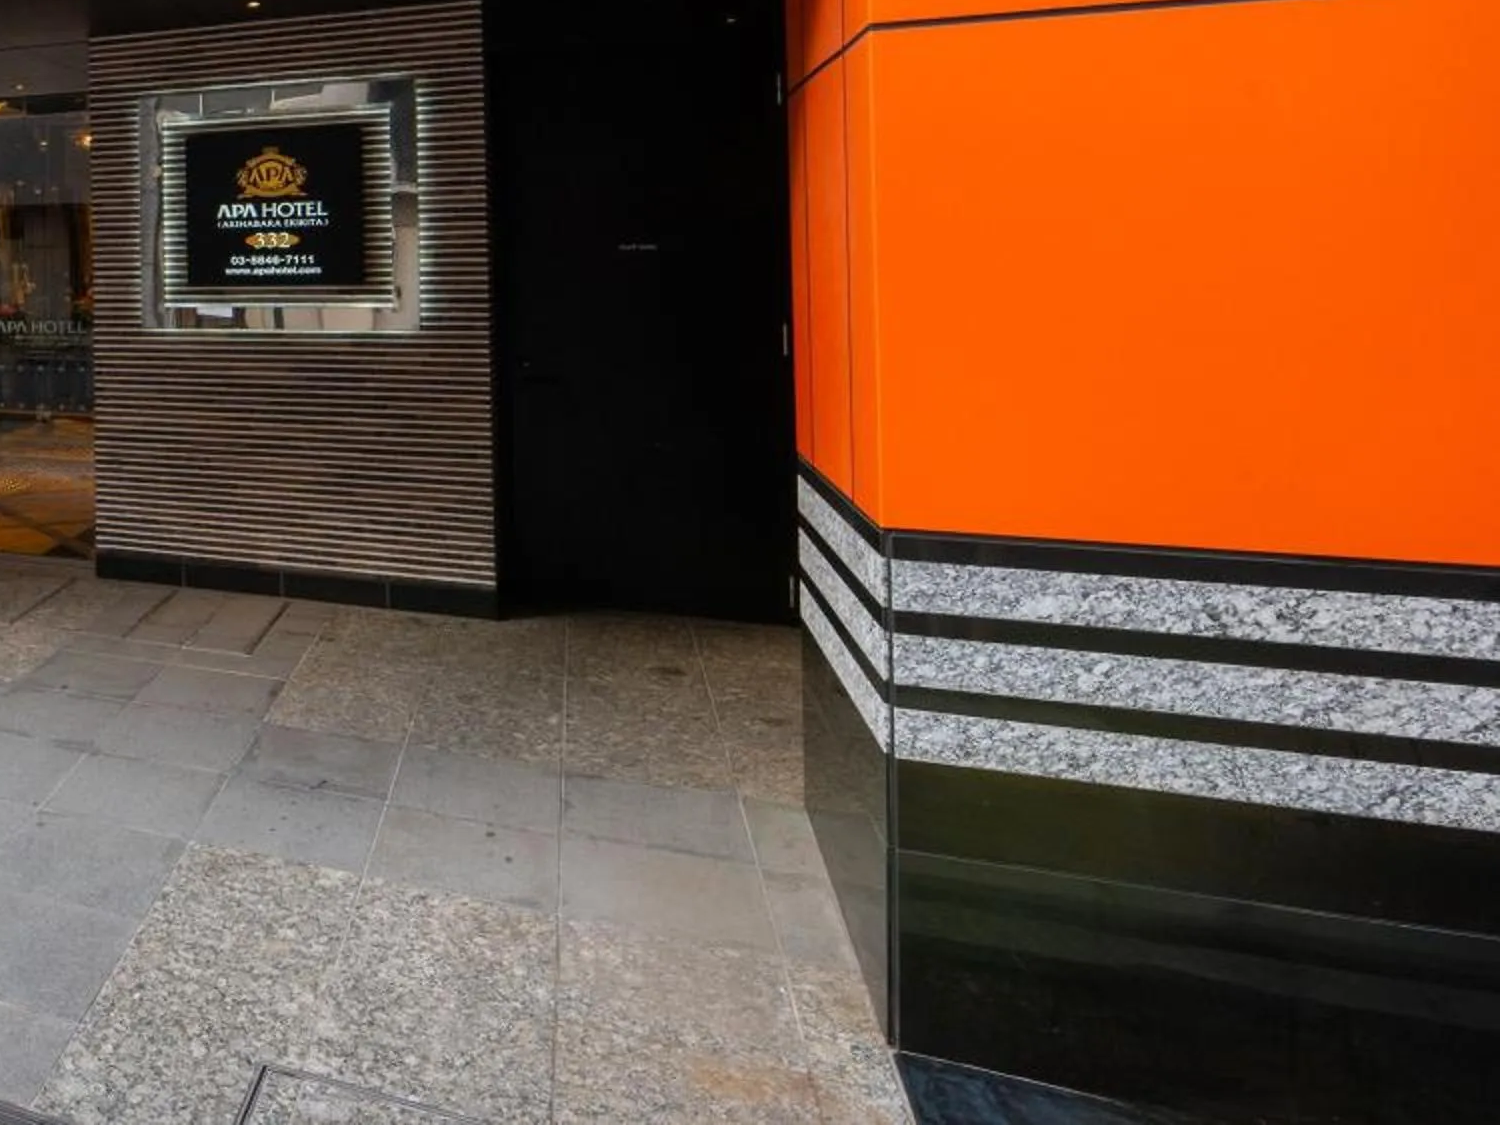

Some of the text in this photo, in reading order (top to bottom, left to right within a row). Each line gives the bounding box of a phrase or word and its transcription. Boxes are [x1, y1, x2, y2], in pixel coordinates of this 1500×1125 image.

[217, 200, 329, 219] APA HOTEL
[254, 231, 291, 249] 332
[30, 320, 87, 334] HOTEL
